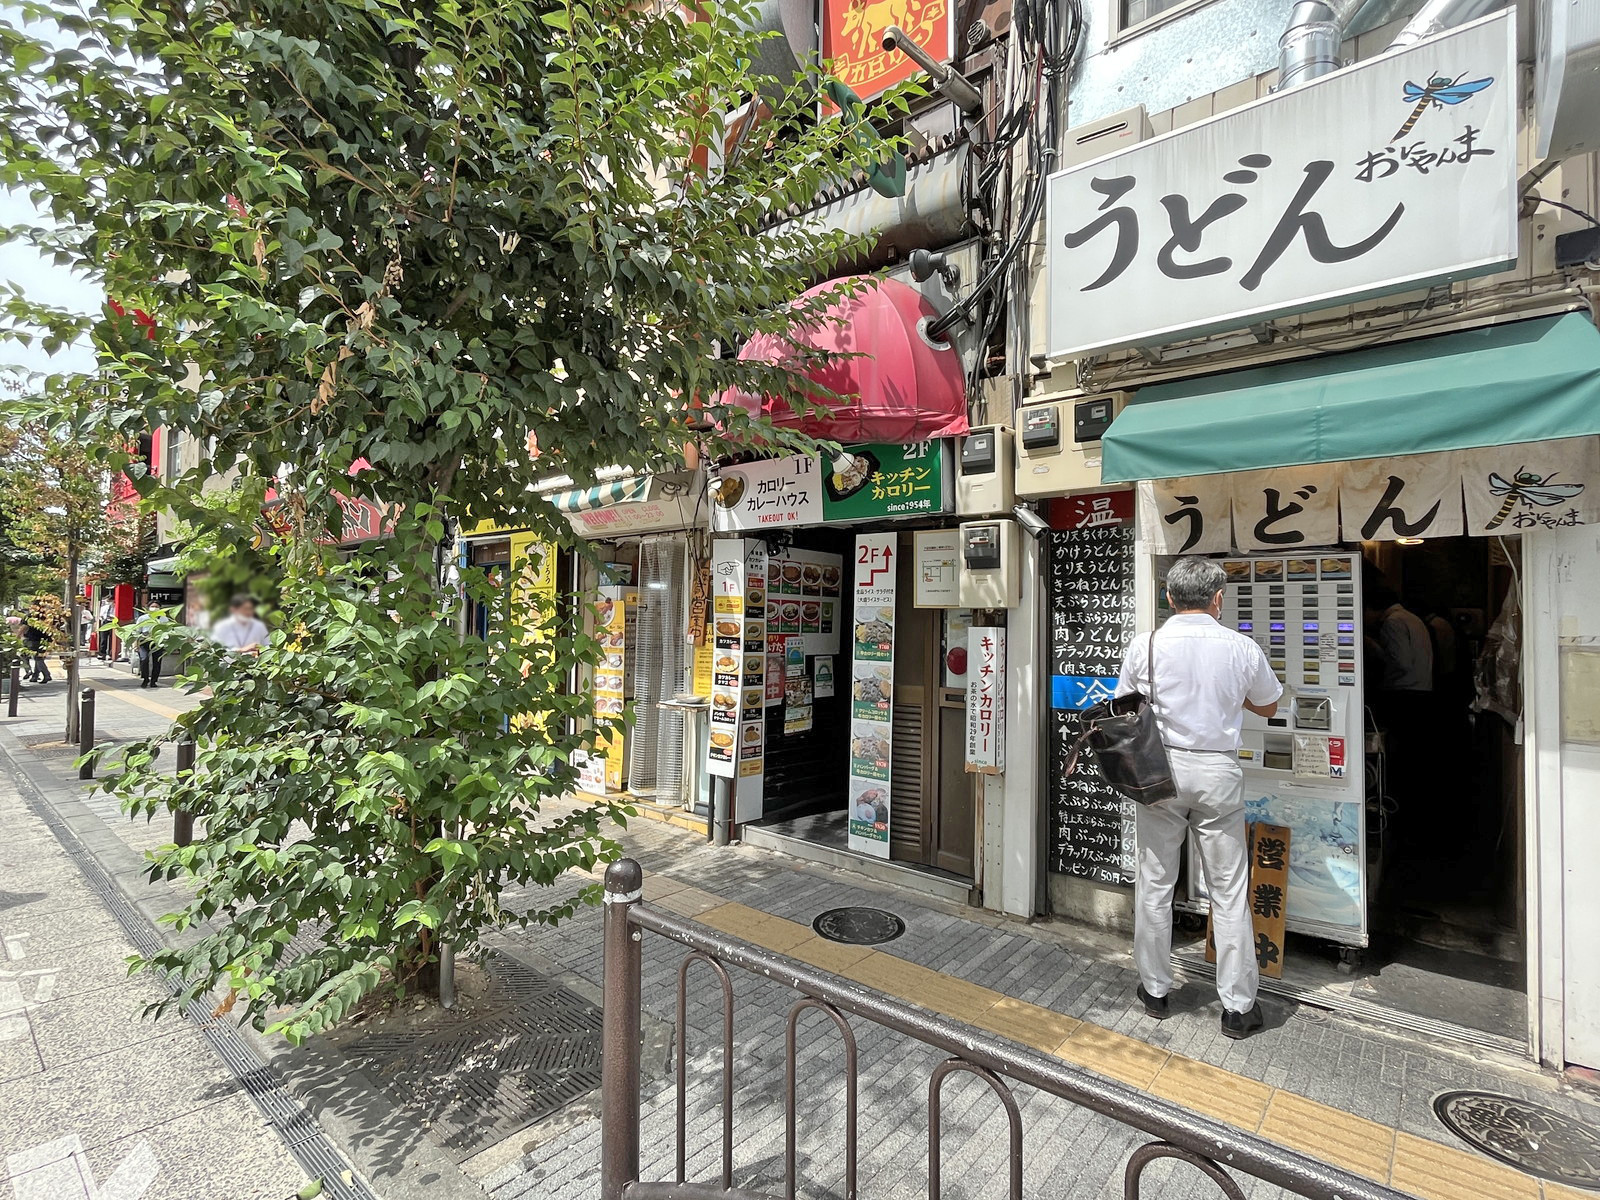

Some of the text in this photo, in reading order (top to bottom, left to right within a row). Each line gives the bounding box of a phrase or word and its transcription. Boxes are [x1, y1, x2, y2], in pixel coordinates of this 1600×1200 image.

[1354, 124, 1496, 183] おにやんま
[1064, 153, 1405, 292] うどん
[902, 440, 932, 460] 2F
[794, 458, 813, 475] 1F
[870, 466, 932, 486] キッチン
[757, 477, 796, 495] カロリー
[870, 482, 931, 501] カロリー
[747, 491, 810, 511] カレーハウス
[758, 513, 784, 523] TAKEOUT
[1075, 497, 1123, 529] 温
[1164, 475, 1442, 553] うどん
[858, 545, 879, 564] 2F
[1056, 545, 1119, 558] かけうどん
[1053, 561, 1120, 576] とり天うどん
[722, 581, 735, 592] 1F
[1054, 577, 1121, 592] きつねうどん
[1121, 595, 1136, 608] 58
[980, 636, 994, 752] キッチンカロリー
[1122, 803, 1136, 817] 58
[1058, 860, 1100, 877] トッピング
[1254, 837, 1287, 969] 営業中
